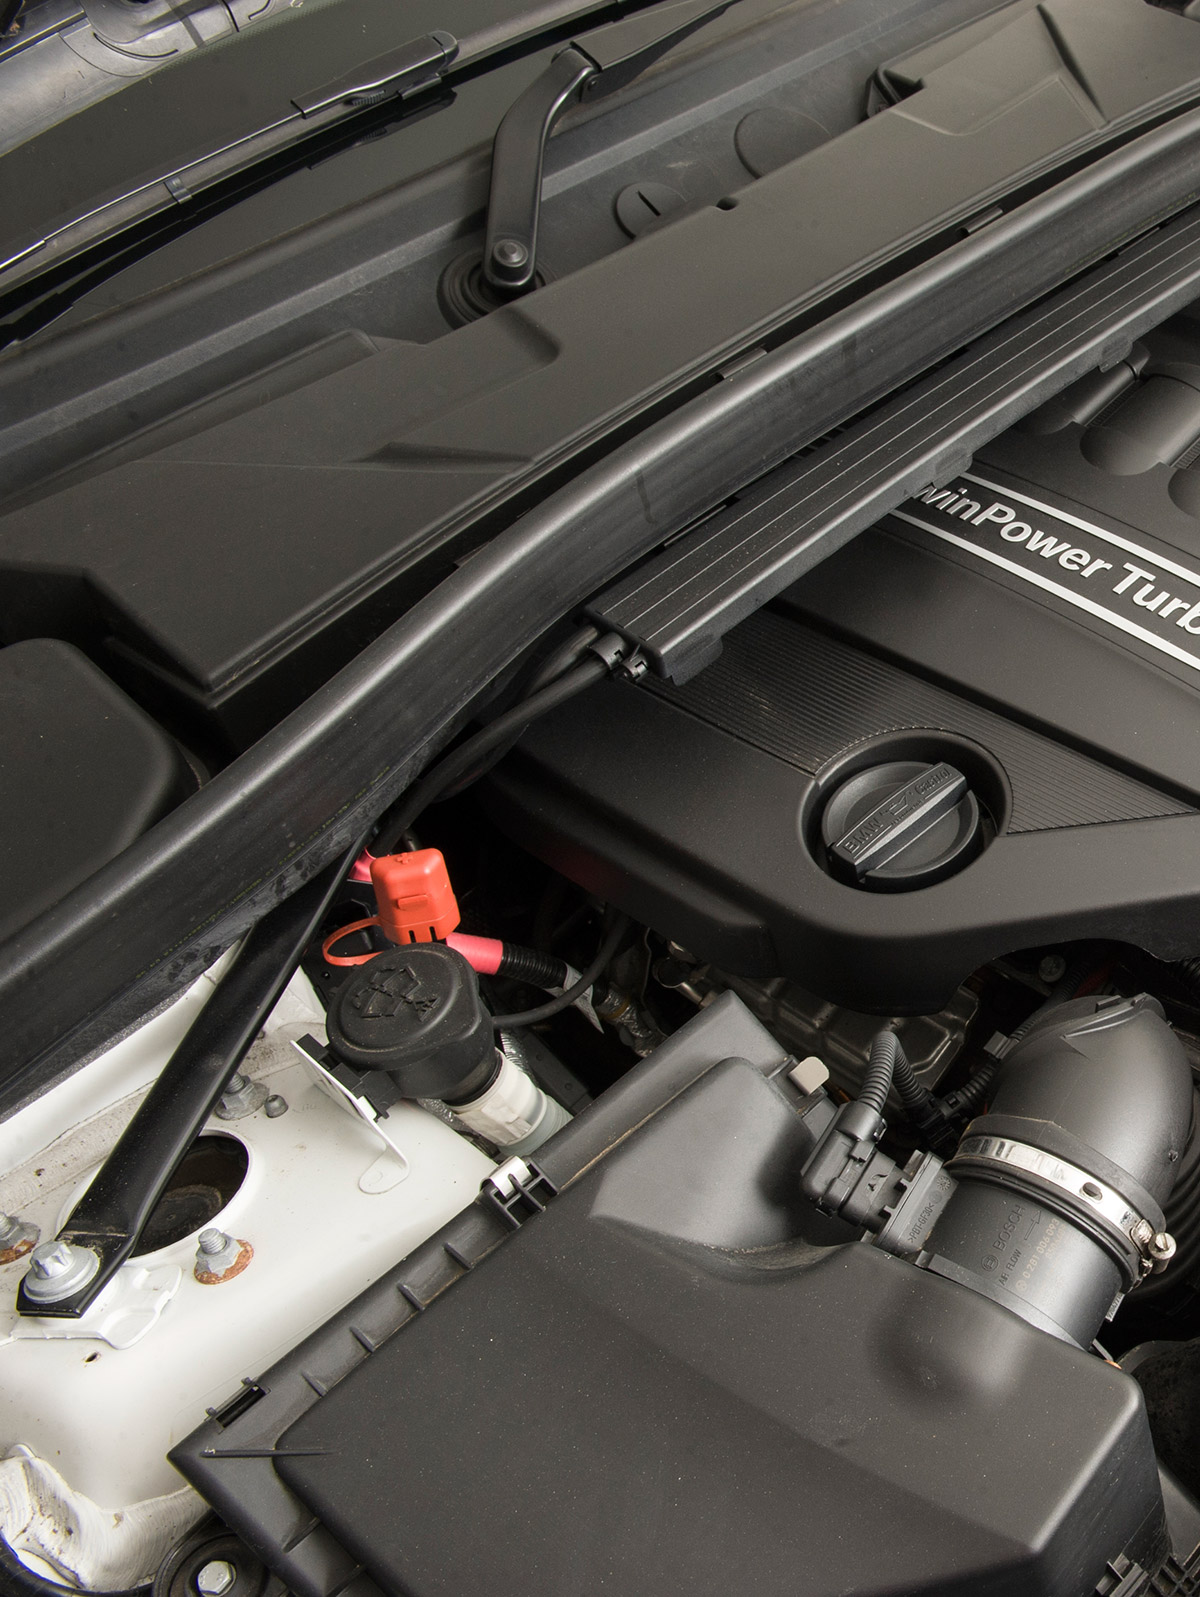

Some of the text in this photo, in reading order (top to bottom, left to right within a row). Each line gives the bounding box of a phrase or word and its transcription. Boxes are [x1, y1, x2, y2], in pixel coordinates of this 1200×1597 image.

[843, 818, 884, 853] BMW
[992, 1204, 1025, 1251] BOSCH
[1026, 1254, 1040, 1271] 281
[1036, 1236, 1050, 1254] 006
[1045, 1218, 1059, 1236] 093
[999, 1248, 1022, 1286] AIR FLOW
